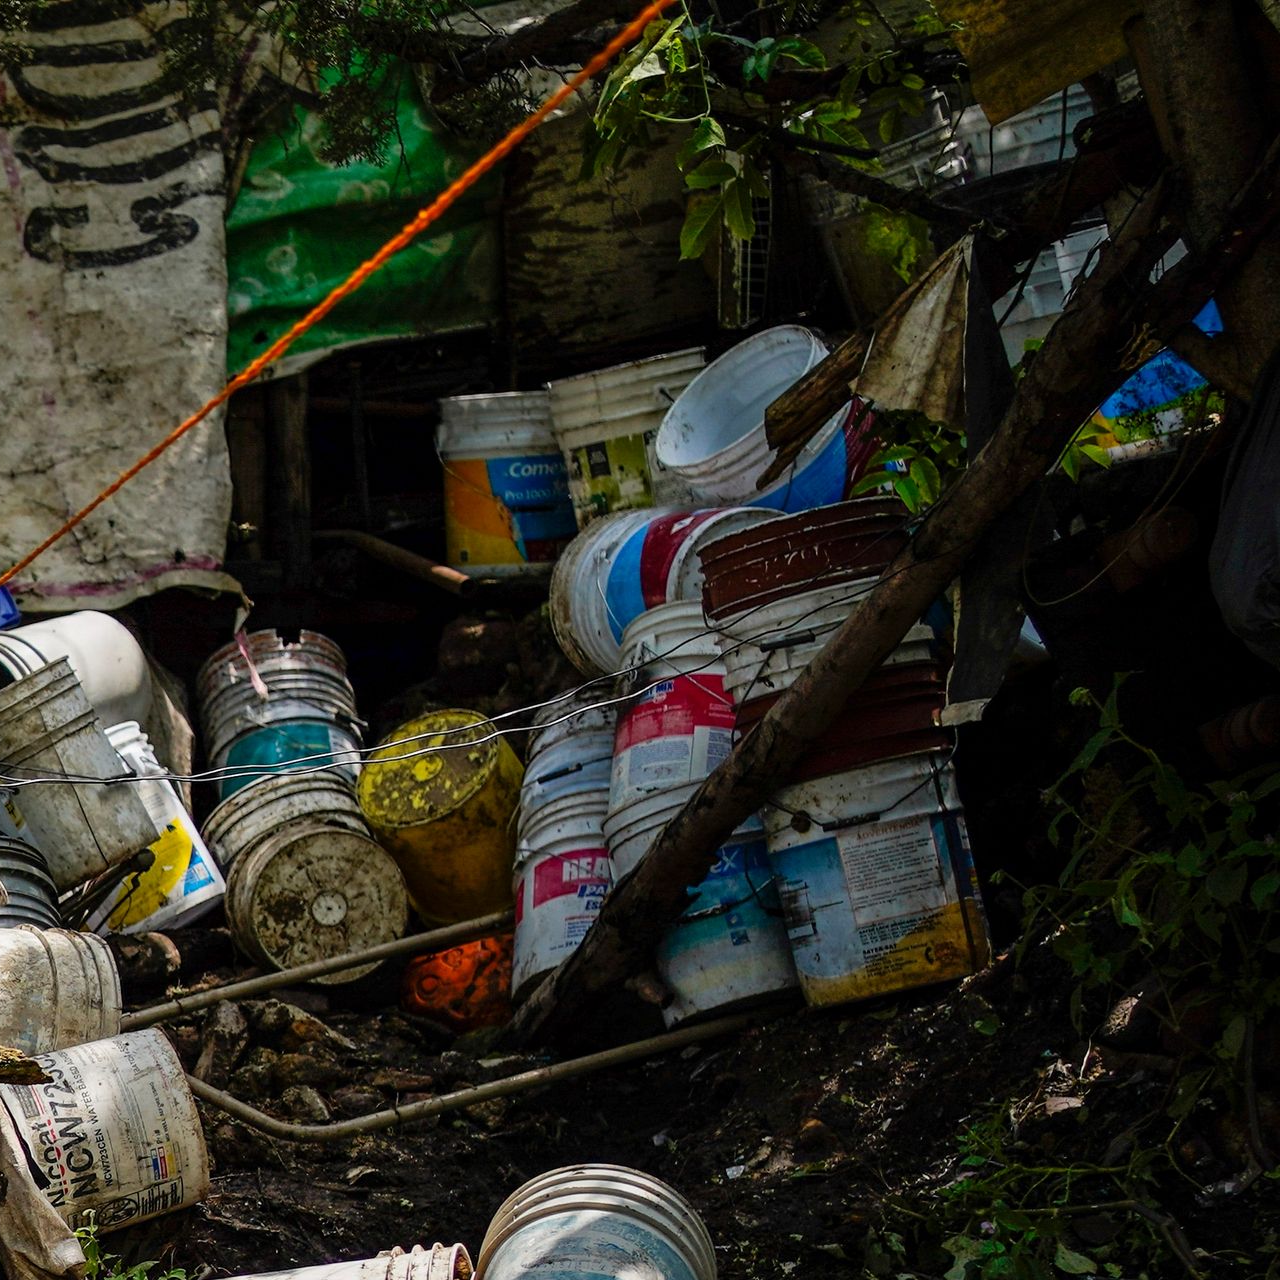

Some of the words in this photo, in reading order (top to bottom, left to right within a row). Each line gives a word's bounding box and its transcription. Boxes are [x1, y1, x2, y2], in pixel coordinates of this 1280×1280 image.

[69, 1064, 87, 1091] BASED
[82, 1091, 100, 1125] WATER
[94, 1128, 114, 1187] NCW723CEN
